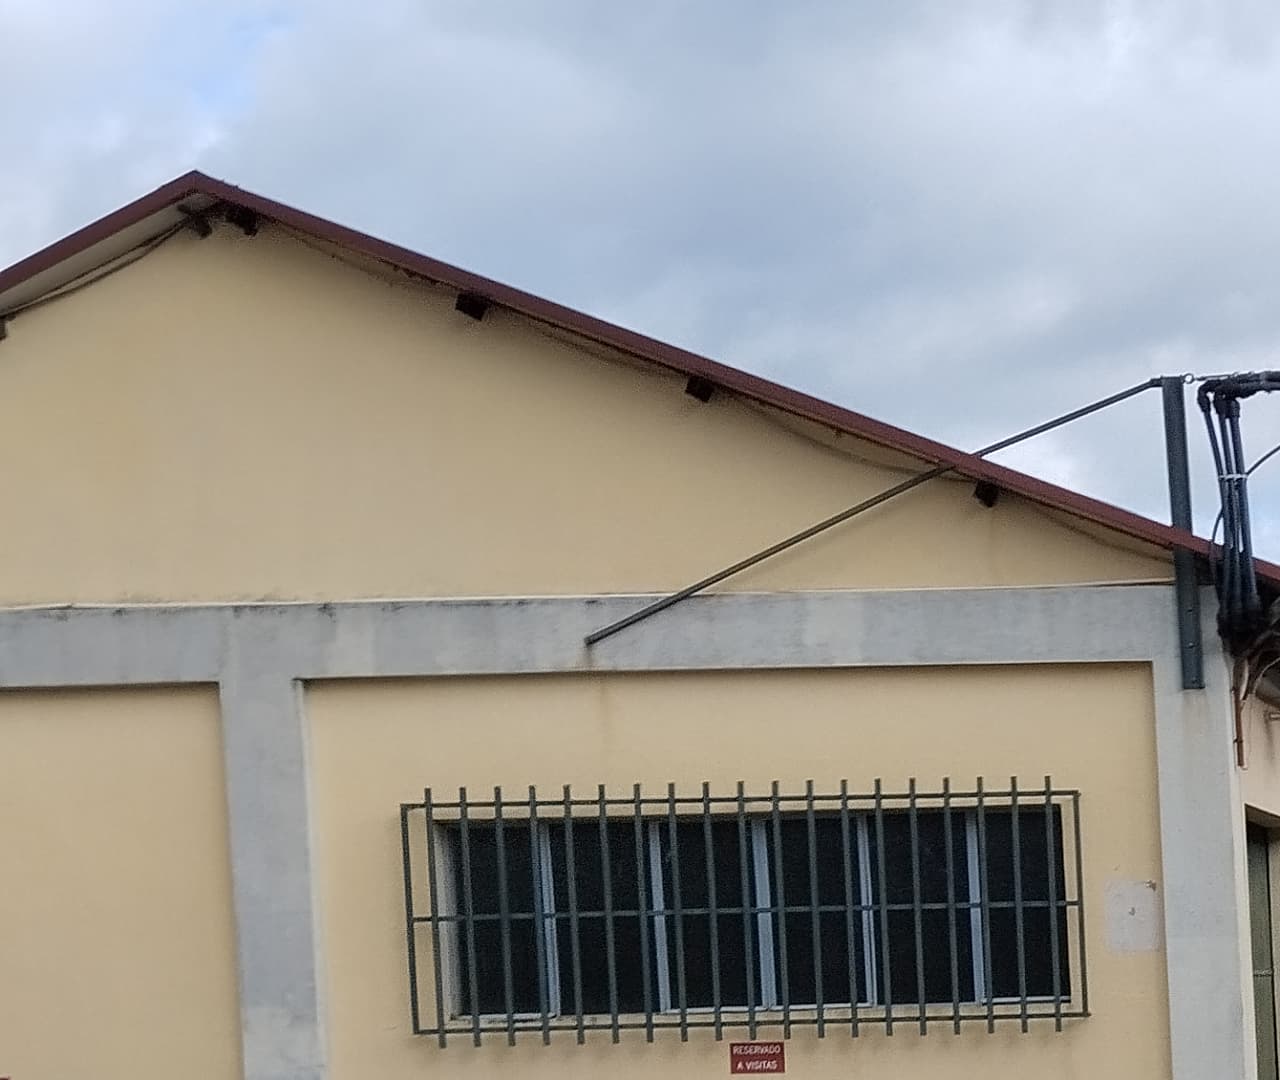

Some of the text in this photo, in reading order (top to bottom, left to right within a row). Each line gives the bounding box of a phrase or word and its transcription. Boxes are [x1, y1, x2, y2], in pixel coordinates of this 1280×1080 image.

[732, 1044, 781, 1055] RESERVADO
[736, 1060, 778, 1070] A VISITAS
